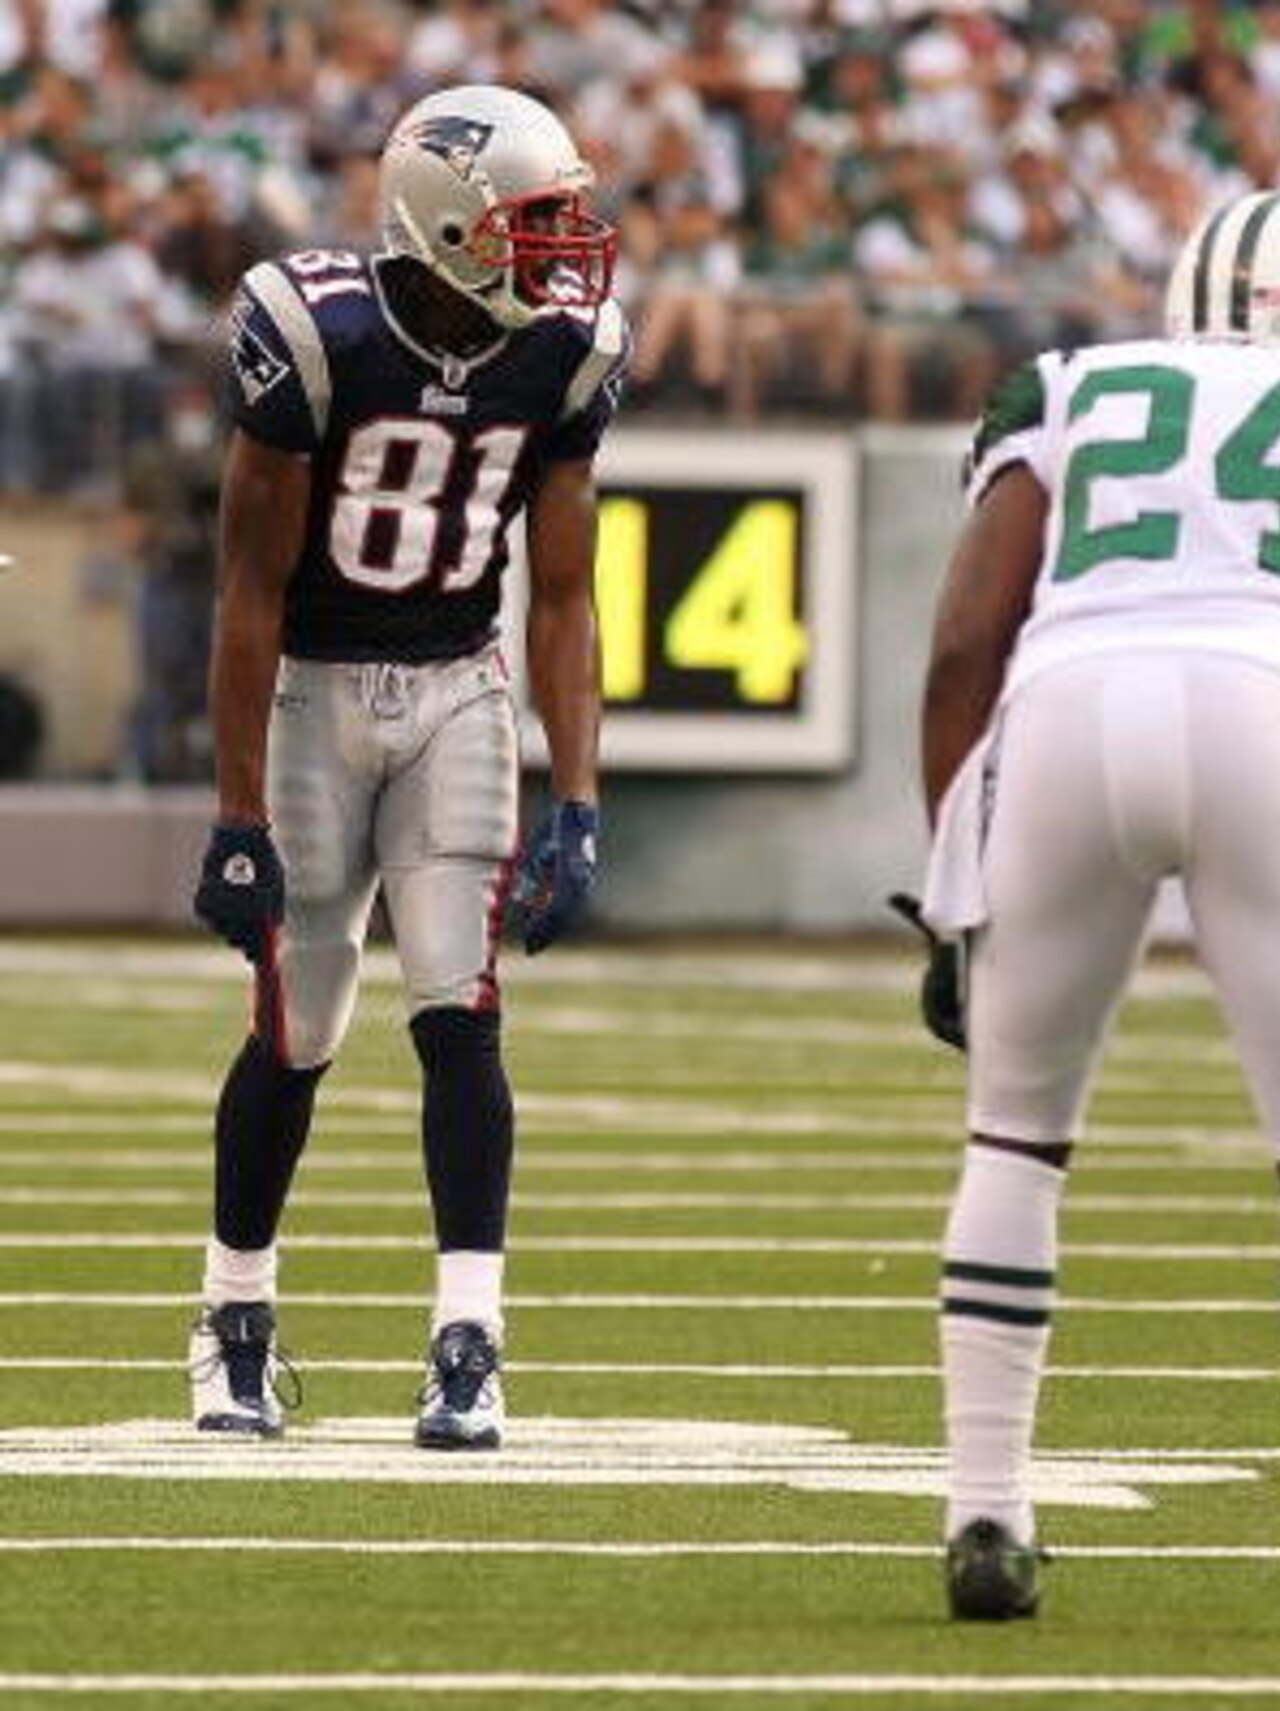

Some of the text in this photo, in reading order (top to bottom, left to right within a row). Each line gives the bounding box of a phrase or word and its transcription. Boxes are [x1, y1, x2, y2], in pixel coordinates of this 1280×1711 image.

[286, 248, 370, 303] 81
[329, 417, 528, 592] 81
[595, 496, 810, 704] 14
